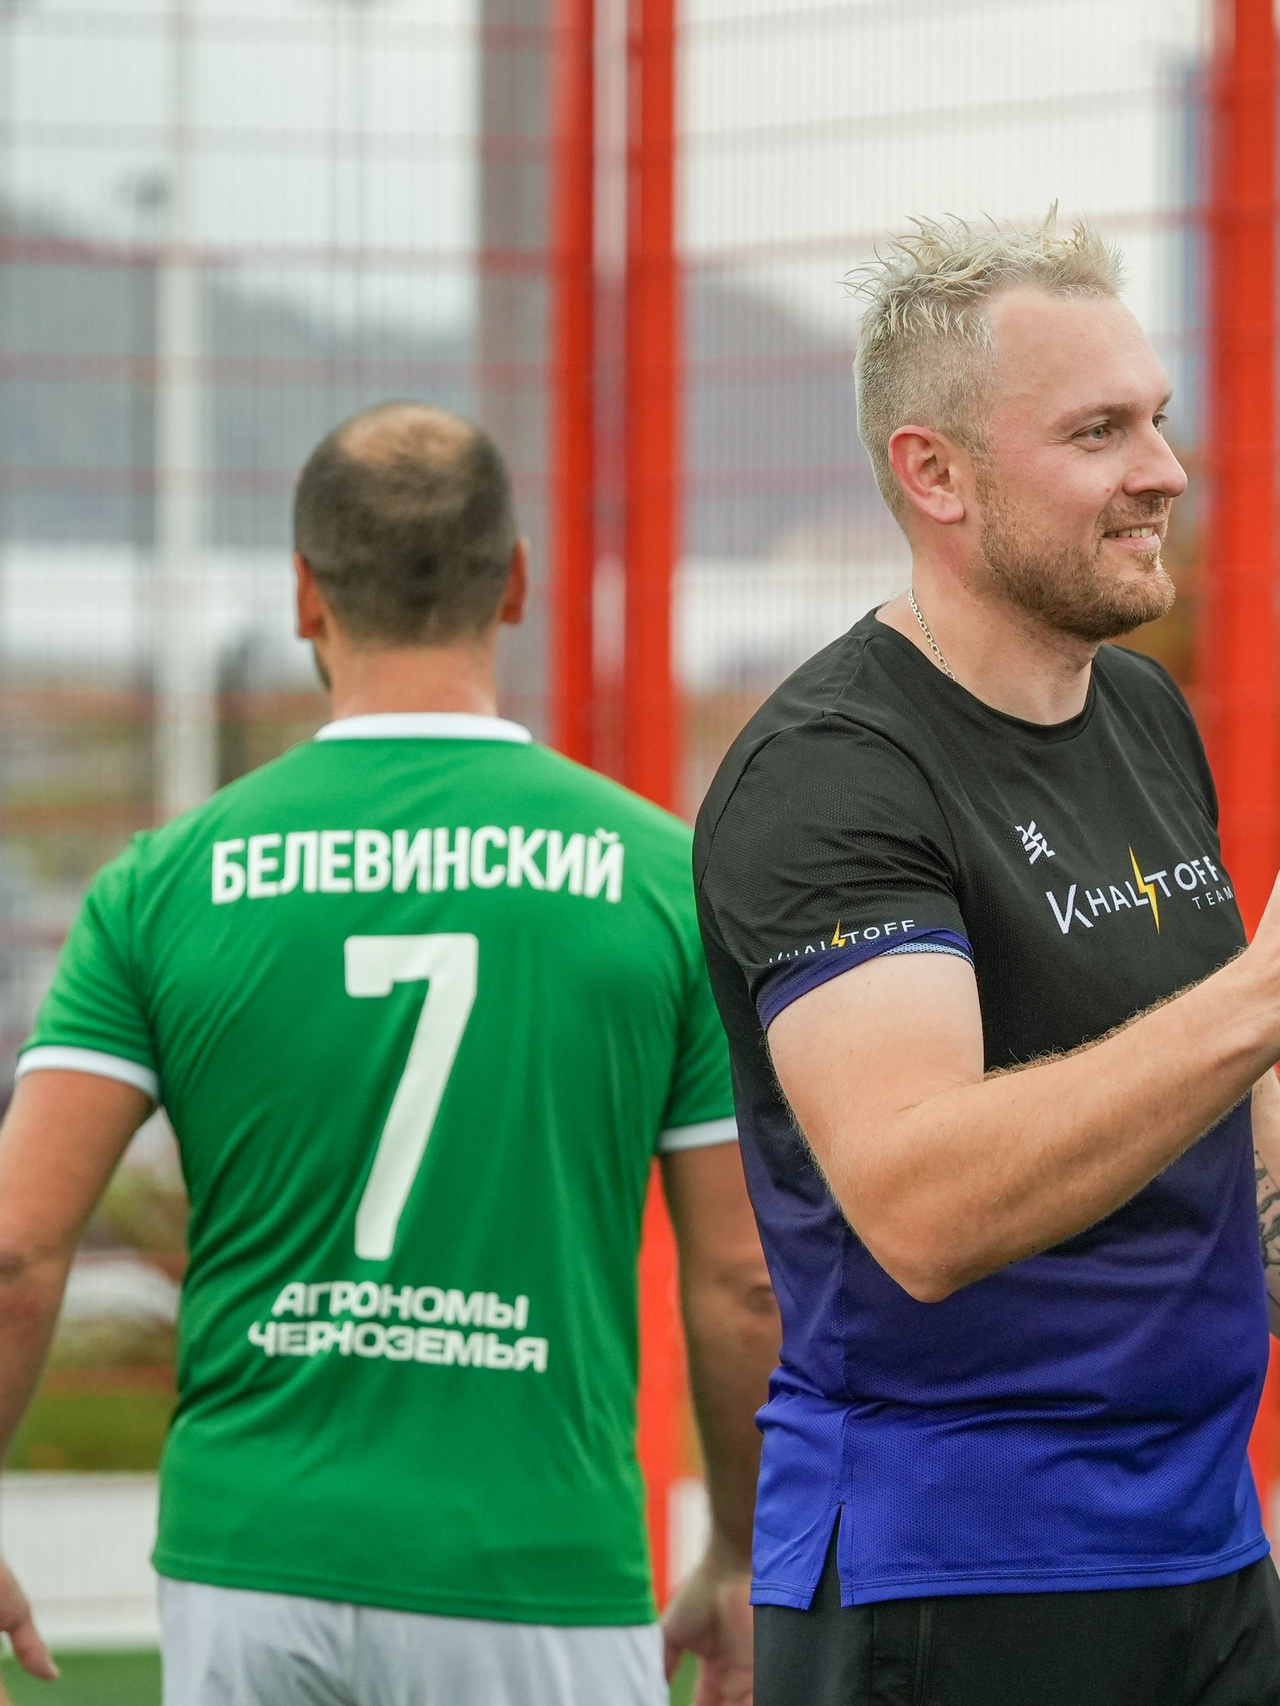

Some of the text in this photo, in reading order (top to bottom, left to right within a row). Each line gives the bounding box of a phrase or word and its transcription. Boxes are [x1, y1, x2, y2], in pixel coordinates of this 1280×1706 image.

[211, 826, 625, 904] БЕЛЕВИНСКИЙ
[1045, 855, 1220, 935] KHALTOFF
[1191, 886, 1234, 910] TEAM
[344, 933, 479, 1261] 7
[271, 1281, 530, 1330] АГРОНОМЫ
[247, 1321, 549, 1372] ЧЕРНОЗЕМЬЯ
